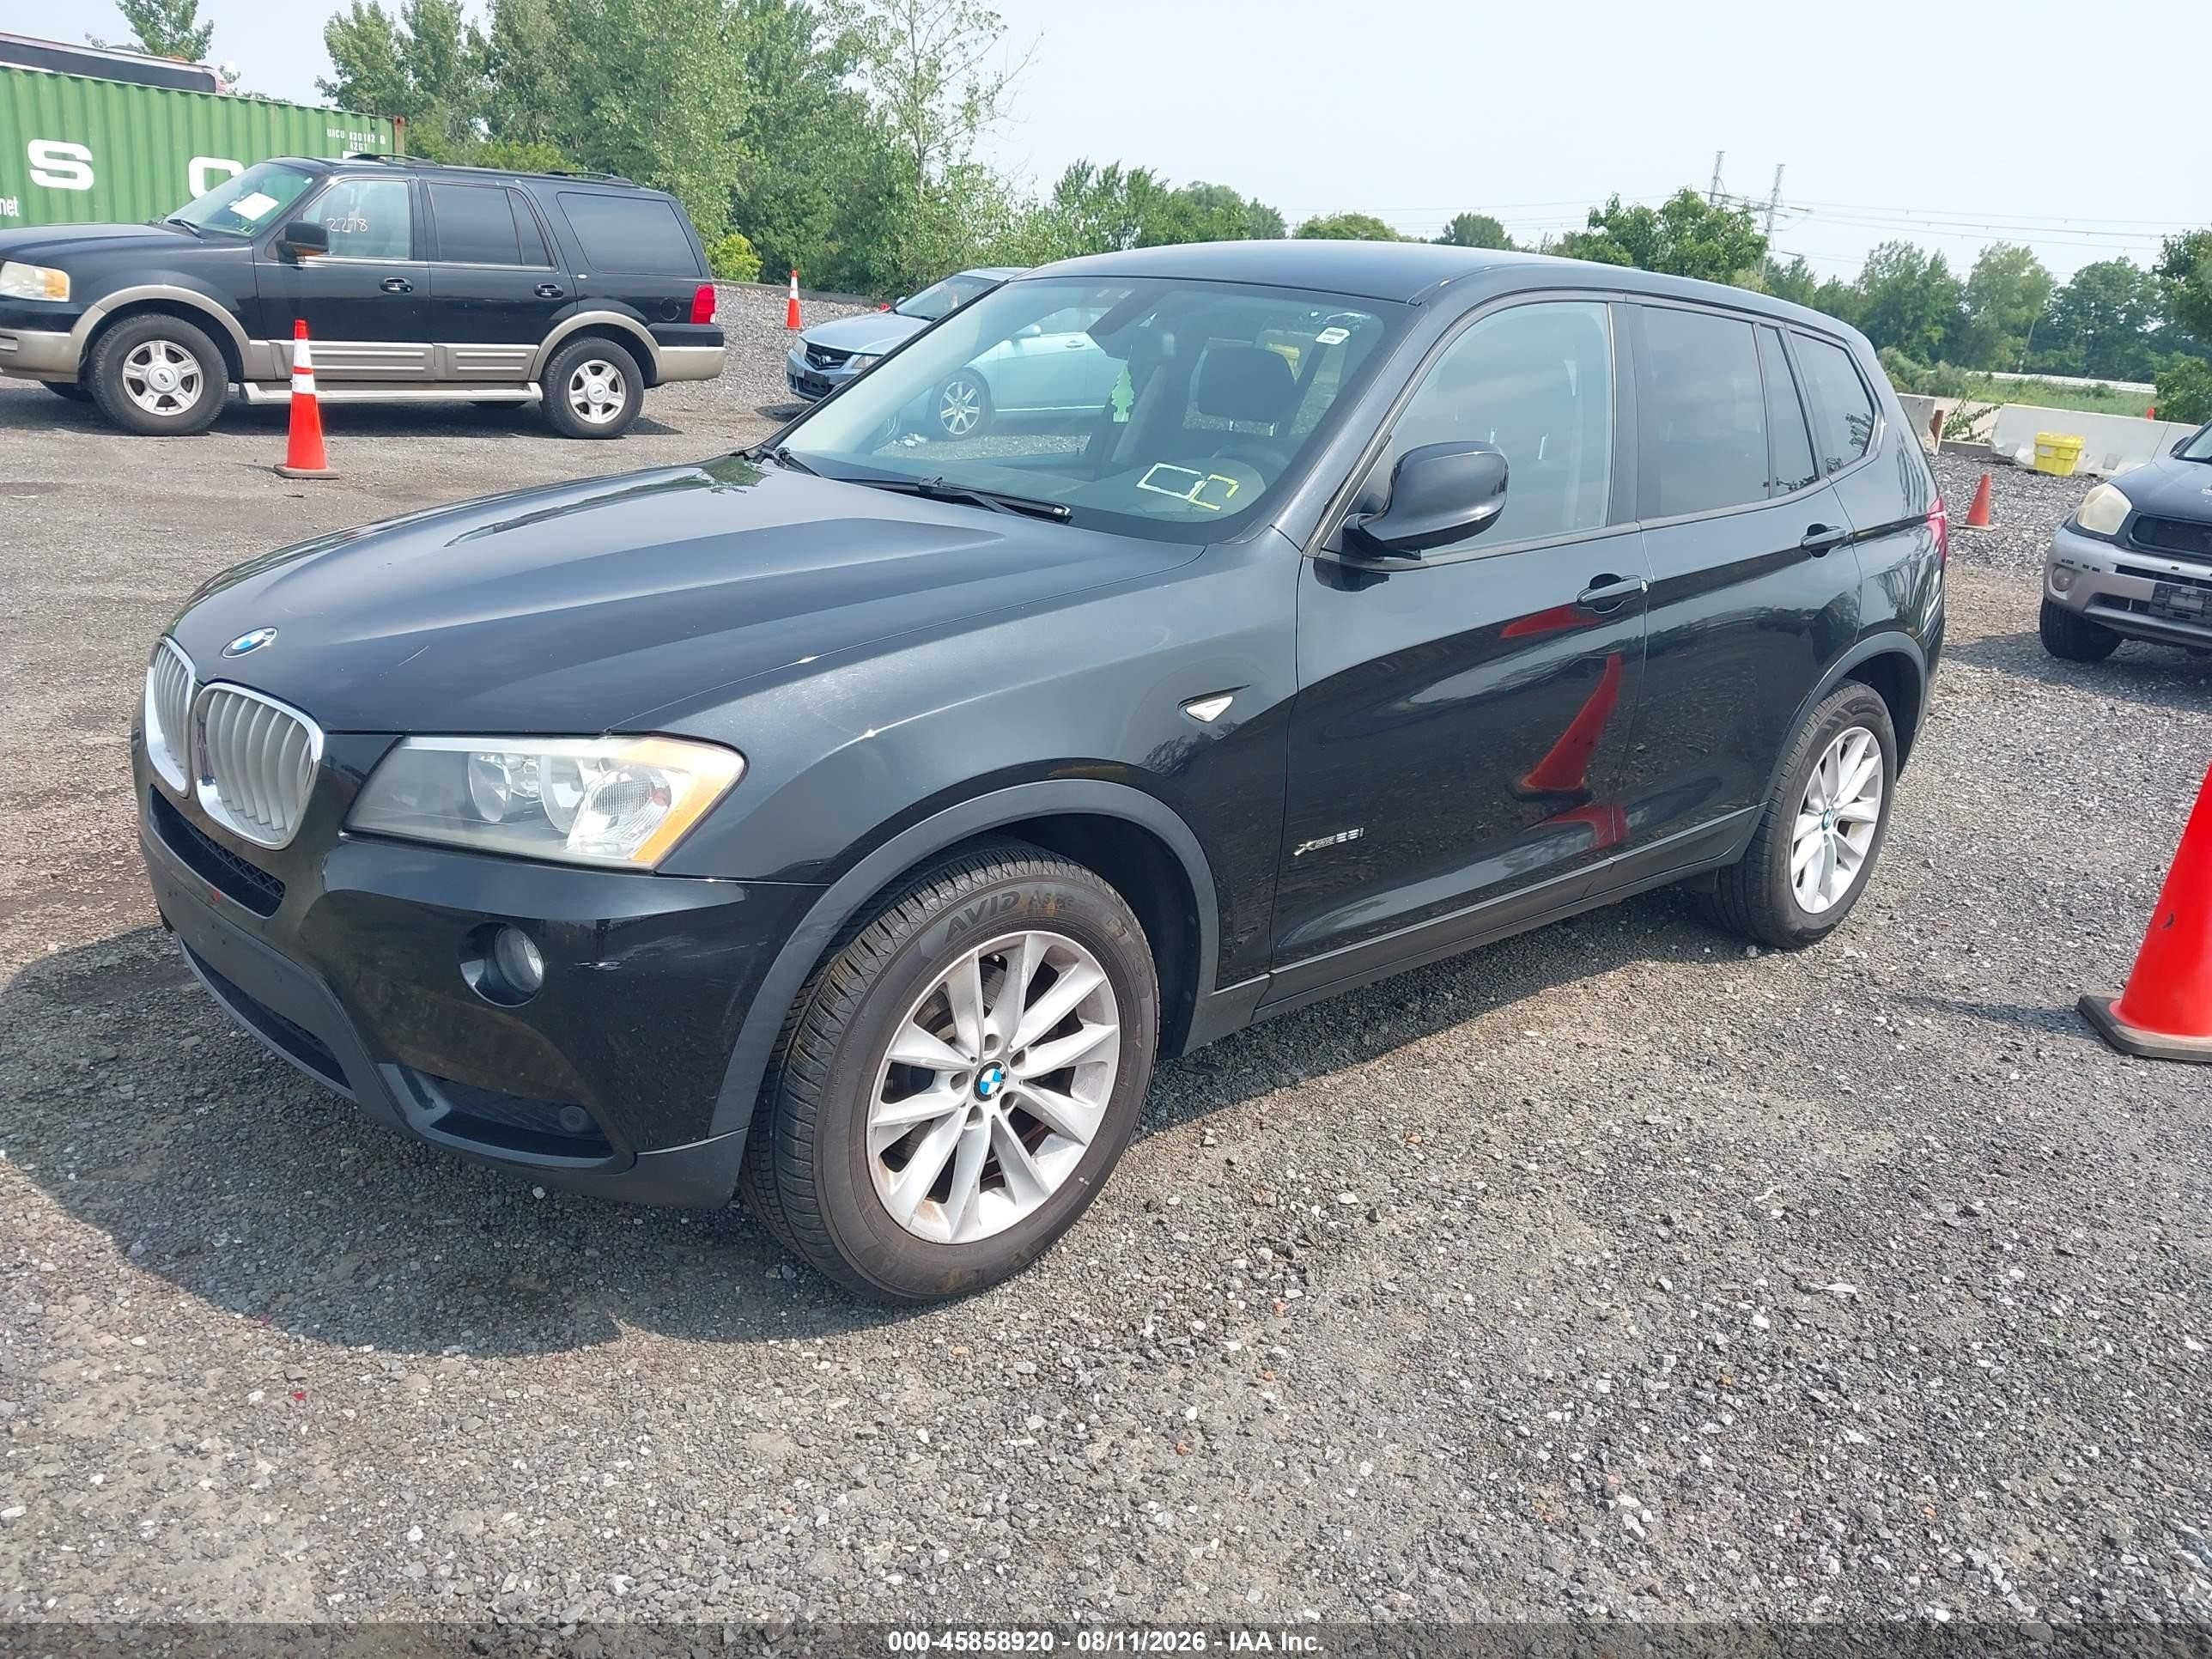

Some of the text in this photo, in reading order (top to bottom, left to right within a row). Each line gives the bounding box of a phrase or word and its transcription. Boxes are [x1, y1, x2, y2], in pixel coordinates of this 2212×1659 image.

[326, 128, 345, 139] UACU
[325, 217, 368, 233] 2278
[944, 890, 1021, 944] AVID
